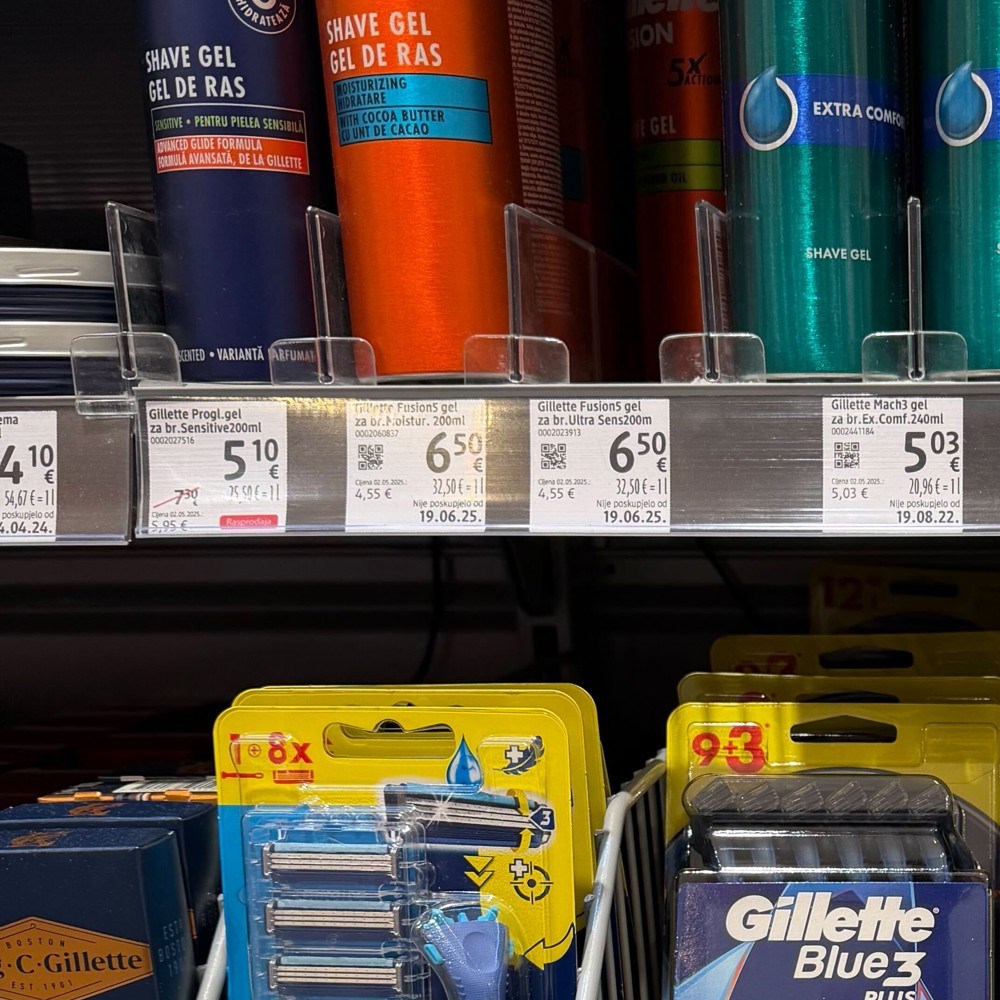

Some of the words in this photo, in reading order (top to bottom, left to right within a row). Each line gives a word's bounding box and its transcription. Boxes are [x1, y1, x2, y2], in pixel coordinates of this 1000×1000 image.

[327, 12, 379, 44] SHAVE
[389, 12, 431, 35] GEL
[146, 45, 191, 73] SHAVE
[198, 45, 236, 68] GEL
[330, 47, 355, 74] GEL
[362, 43, 387, 68] DE
[397, 42, 442, 66] RAS
[149, 79, 170, 102] GEL
[175, 76, 197, 98] DE
[205, 76, 246, 98] RAS
[337, 77, 407, 96] MOISTURIZING
[813, 102, 862, 118] EXTRA
[195, 116, 227, 127] PENTRU
[231, 116, 260, 128] PIELEA
[340, 113, 358, 127] WITH
[363, 110, 397, 123] COCOA
[402, 110, 444, 122] BUTTER
[353, 126, 369, 139] UNT
[374, 125, 386, 136] DE
[390, 123, 429, 135] CACAO
[157, 139, 188, 153] ADVANCED
[191, 138, 214, 150] GLIDE
[217, 138, 262, 151] FORMULA
[239, 154, 250, 164] DE
[253, 154, 264, 165] LA
[267, 155, 302, 169] GILLETTE
[806, 248, 847, 260] SHAVE
[851, 249, 871, 260] GEL
[217, 346, 264, 360] VARIANTĂ
[538, 401, 576, 412] Gillette
[580, 402, 621, 411] Fusion5
[625, 401, 641, 413] gel
[832, 400, 870, 410] Gillette
[874, 400, 907, 410] Mach3
[911, 399, 927, 412] gel
[149, 409, 188, 419] Gillette
[192, 408, 241, 421] Progl.gel
[538, 416, 549, 425] za
[554, 415, 594, 425] br.Ultra
[598, 415, 652, 425] Sens200m
[832, 415, 842, 424] za
[150, 424, 162, 433] za
[596, 500, 610, 509] Nije
[614, 500, 655, 509] poskupjelo
[604, 511, 666, 523] 19.06.25.
[897, 511, 959, 523] 19.08.22.
[726, 892, 935, 942] Gillette
[794, 945, 926, 987] Blue3
